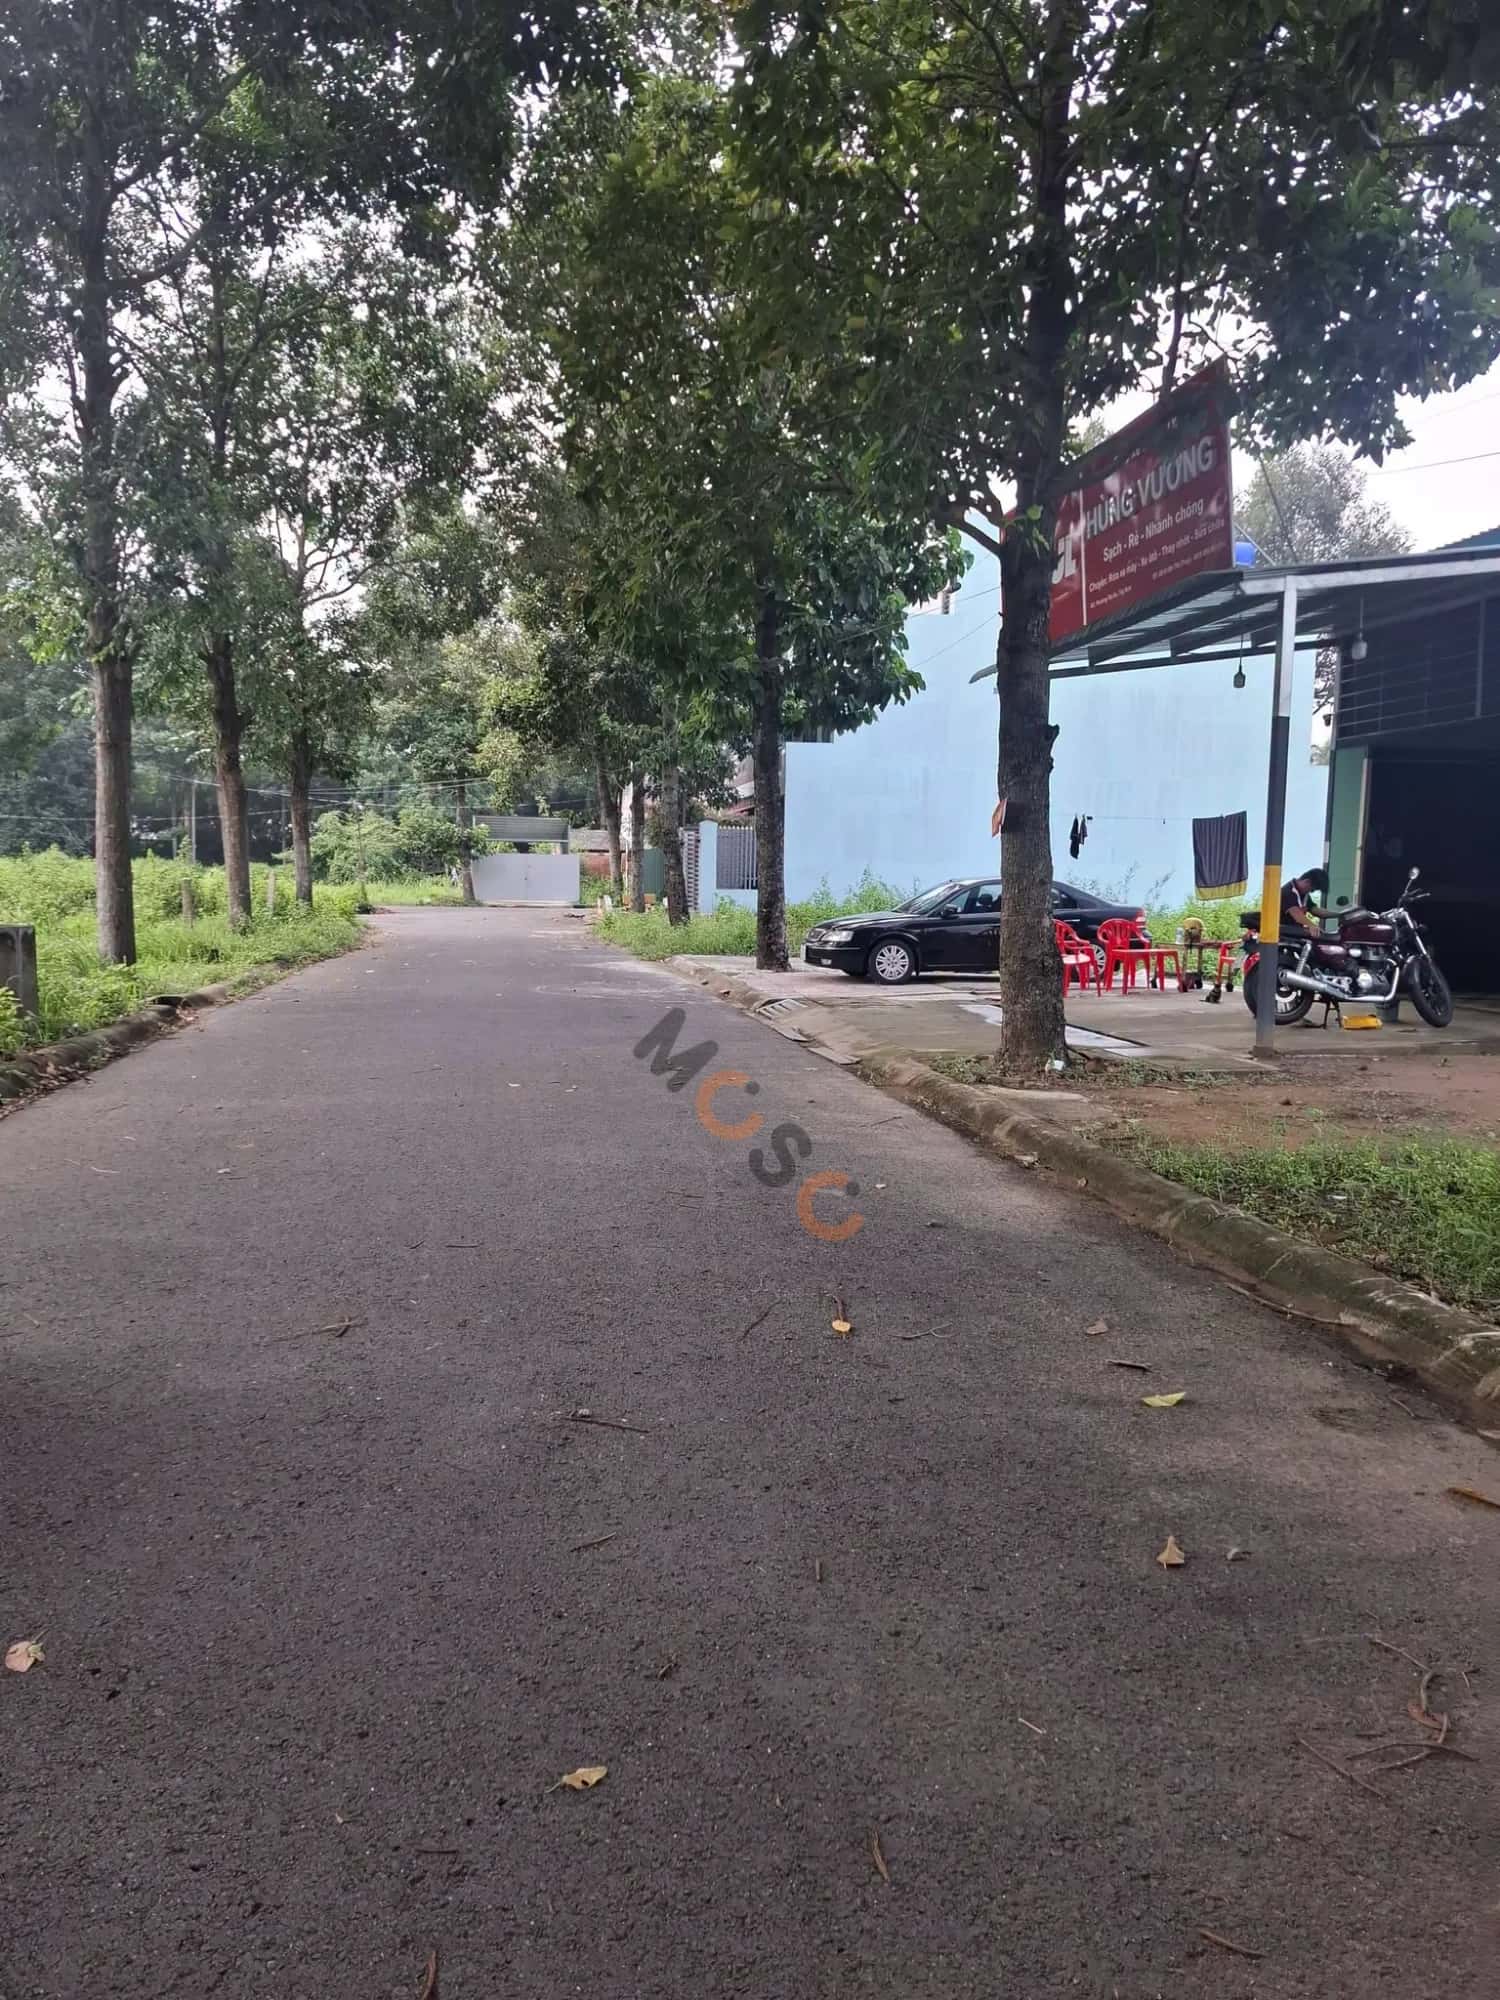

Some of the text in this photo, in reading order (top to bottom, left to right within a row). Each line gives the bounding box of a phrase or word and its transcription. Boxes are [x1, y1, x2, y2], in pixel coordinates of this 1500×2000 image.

[1087, 489, 1136, 539] HÙNG
[1137, 435, 1216, 507] VƯƠNG
[1103, 541, 1122, 563] Sạch
[1145, 512, 1173, 540] Nhanh
[1175, 498, 1204, 523] chóng
